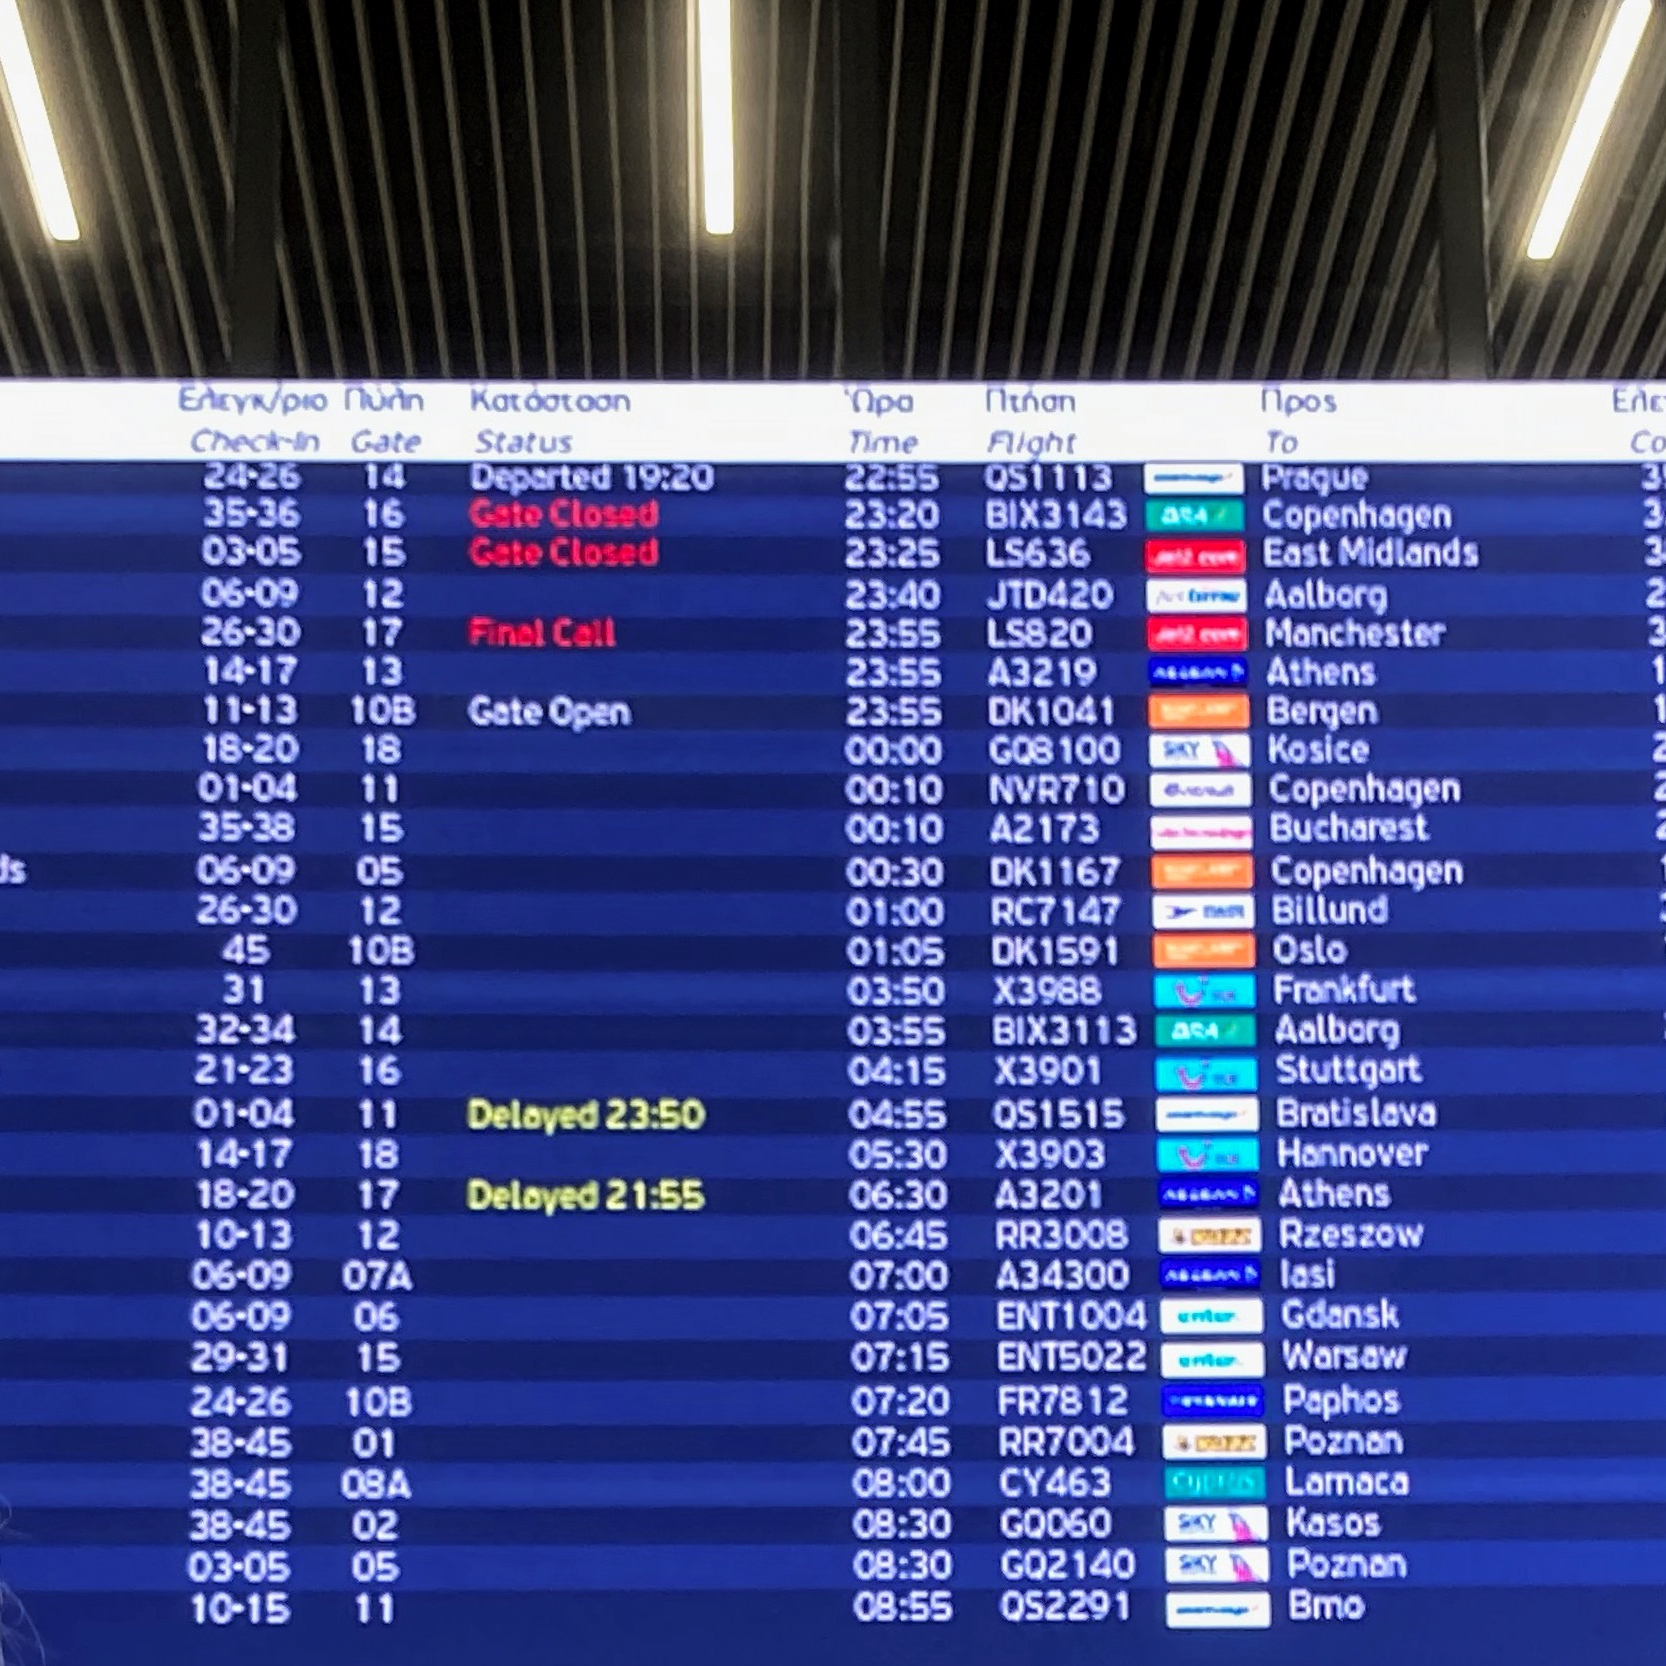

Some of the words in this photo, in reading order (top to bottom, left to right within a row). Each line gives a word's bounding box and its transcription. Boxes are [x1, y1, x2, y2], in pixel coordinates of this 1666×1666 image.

[190, 428, 320, 454] Check-In
[351, 429, 422, 454] Gate
[475, 429, 573, 454] Status
[850, 430, 919, 454] Time
[987, 430, 1077, 460] Flight
[1268, 430, 1300, 454] To
[470, 462, 611, 496] Departed
[623, 462, 715, 491] 19:20
[845, 462, 939, 491] 22:55
[1262, 462, 1369, 497] Prague
[468, 497, 544, 528] Gate
[550, 497, 660, 528] Closed
[1263, 498, 1452, 536] Copenhagen
[468, 535, 544, 567] Gate
[550, 535, 660, 567] Closed
[845, 537, 940, 568] 23:25
[1264, 535, 1333, 567] East
[1339, 535, 1479, 567] Midlands
[1264, 578, 1388, 616] Aalborg
[468, 615, 545, 647] Final
[552, 615, 617, 647] Call
[845, 617, 941, 649] 23:55
[1265, 616, 1447, 648] Manchester
[1266, 655, 1376, 687] Athens
[351, 694, 416, 725] 10B
[468, 695, 544, 726] Gate
[550, 695, 631, 731] Open
[846, 695, 943, 727] 23:55
[1267, 694, 1378, 732] Bergen
[1268, 733, 1370, 764] Kosice
[845, 773, 943, 805] 00:10
[1269, 771, 1461, 810] Copenhagen
[1270, 811, 1430, 842] Bucharest
[846, 856, 944, 887] 00:30
[1271, 853, 1464, 892] Copenhagen
[1272, 893, 1388, 925] Billund
[350, 934, 415, 965] 10B
[847, 935, 945, 967] 01:05
[1273, 933, 1348, 965] Oslo
[1273, 972, 1417, 1005] Frankfurt
[847, 1015, 946, 1046] 03:55
[1275, 1012, 1400, 1051] Aalborg
[1276, 1053, 1423, 1091] Stuttgart
[467, 1097, 600, 1136] Delayed
[606, 1097, 706, 1130] 23:50
[848, 1098, 947, 1130] 04:55
[1276, 1096, 1437, 1128] Bratislava
[1277, 1136, 1430, 1168] Hannover
[467, 1178, 600, 1217] Delayed
[606, 1178, 706, 1211] 21:55
[849, 1179, 948, 1210] 06:30
[1279, 1176, 1391, 1208] Athens
[1279, 1216, 1424, 1249] Rzeszow
[342, 1259, 413, 1291] 07A
[850, 1259, 948, 1291] 07:00
[1281, 1257, 1335, 1289] Iasi
[1281, 1297, 1400, 1329] Gdansk
[851, 1340, 950, 1372] 07:15
[1282, 1338, 1407, 1371] Warsaw
[347, 1385, 412, 1417] 10B
[1283, 1382, 1401, 1422] Paphos
[353, 1426, 393, 1458] 01
[852, 1425, 951, 1457] 07:45
[1284, 1423, 1404, 1456] Poznan
[341, 1467, 412, 1500] 08A
[852, 1507, 952, 1539] 08:30
[1178, 1512, 1217, 1533] SKY
[1287, 1506, 1381, 1538] Kasos
[1179, 1553, 1218, 1575] SKY
[1288, 1546, 1407, 1579] Poznan
[356, 1592, 393, 1624] 11
[853, 1590, 953, 1622] 08:55
